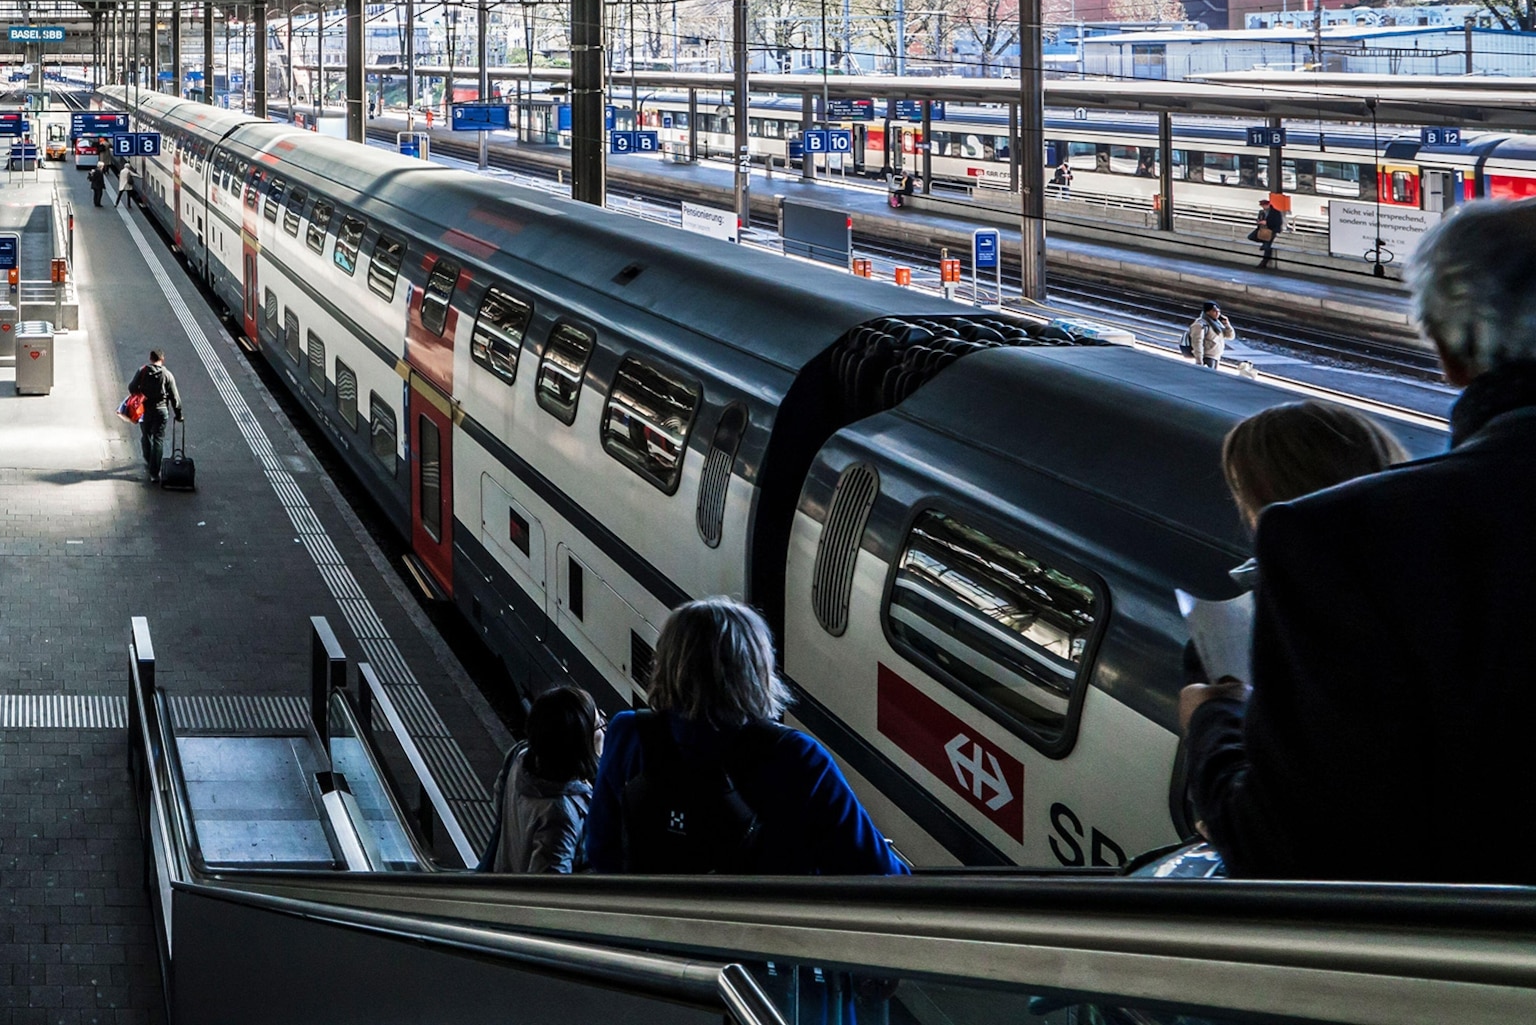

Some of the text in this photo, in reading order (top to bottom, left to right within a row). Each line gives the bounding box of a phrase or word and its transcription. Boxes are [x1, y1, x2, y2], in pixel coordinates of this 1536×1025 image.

[10, 29, 63, 40] BASEL SBB
[617, 137, 627, 150] 9
[641, 137, 652, 150] B
[810, 138, 821, 149] B
[831, 138, 847, 149] 10
[1252, 134, 1262, 144] 11
[1272, 134, 1281, 144] B
[1428, 133, 1437, 143] B
[1444, 133, 1457, 144] 12
[120, 140, 130, 152] B
[144, 140, 153, 152] 8
[1455, 171, 1463, 182] 1
[1342, 207, 1361, 216] Nicht
[1362, 209, 1375, 217] viel
[1339, 218, 1367, 226] sondern
